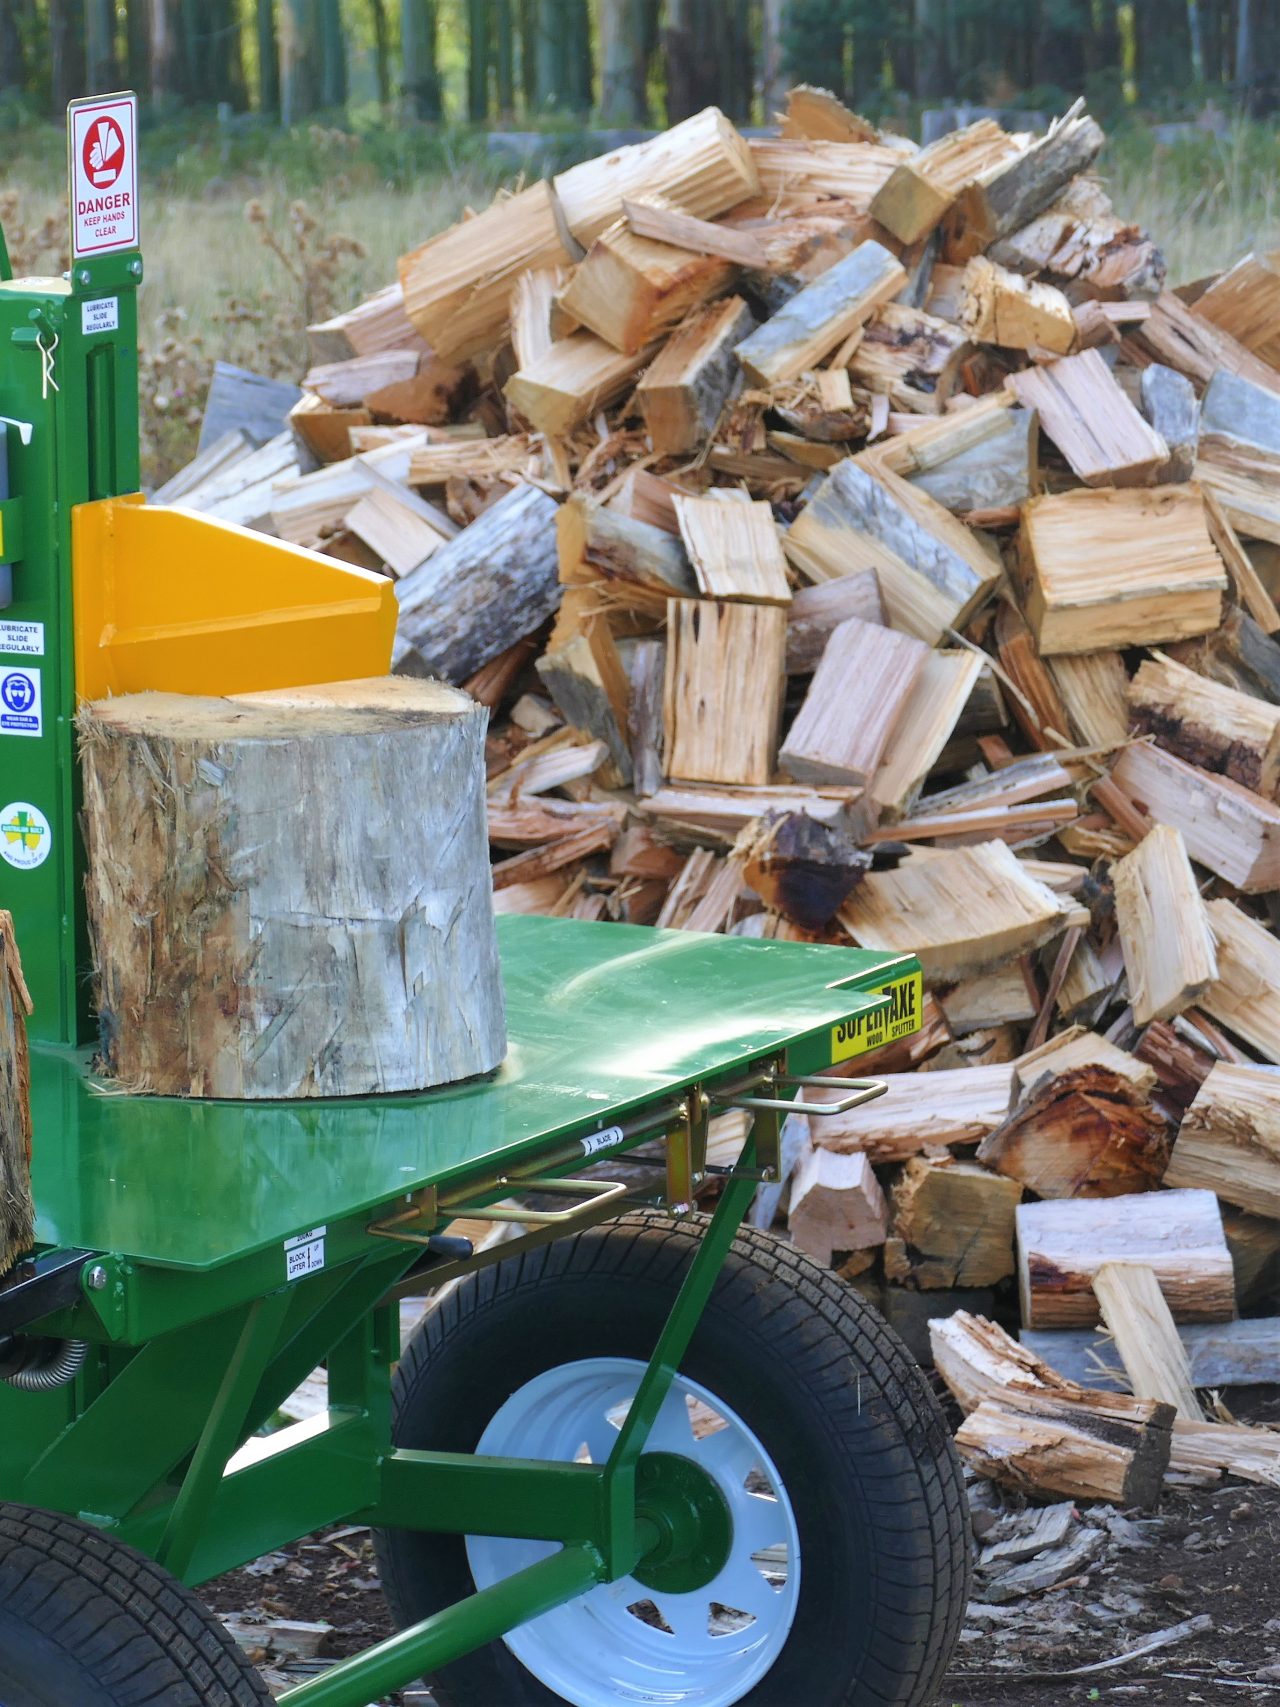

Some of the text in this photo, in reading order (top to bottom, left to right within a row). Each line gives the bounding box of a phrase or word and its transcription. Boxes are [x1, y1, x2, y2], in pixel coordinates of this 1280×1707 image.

[78, 192, 131, 215] DANGER
[84, 211, 125, 226] KEEP HANDS
[95, 226, 117, 238] CLEAR
[87, 301, 114, 312] LUBRICATE
[86, 321, 115, 331] REGULARLY
[7, 634, 28, 642] SLIDE
[866, 1019, 915, 1048] WOOD SPLITTER
[289, 1251, 306, 1264] BLOCK
[289, 1261, 306, 1274] LIFTER
